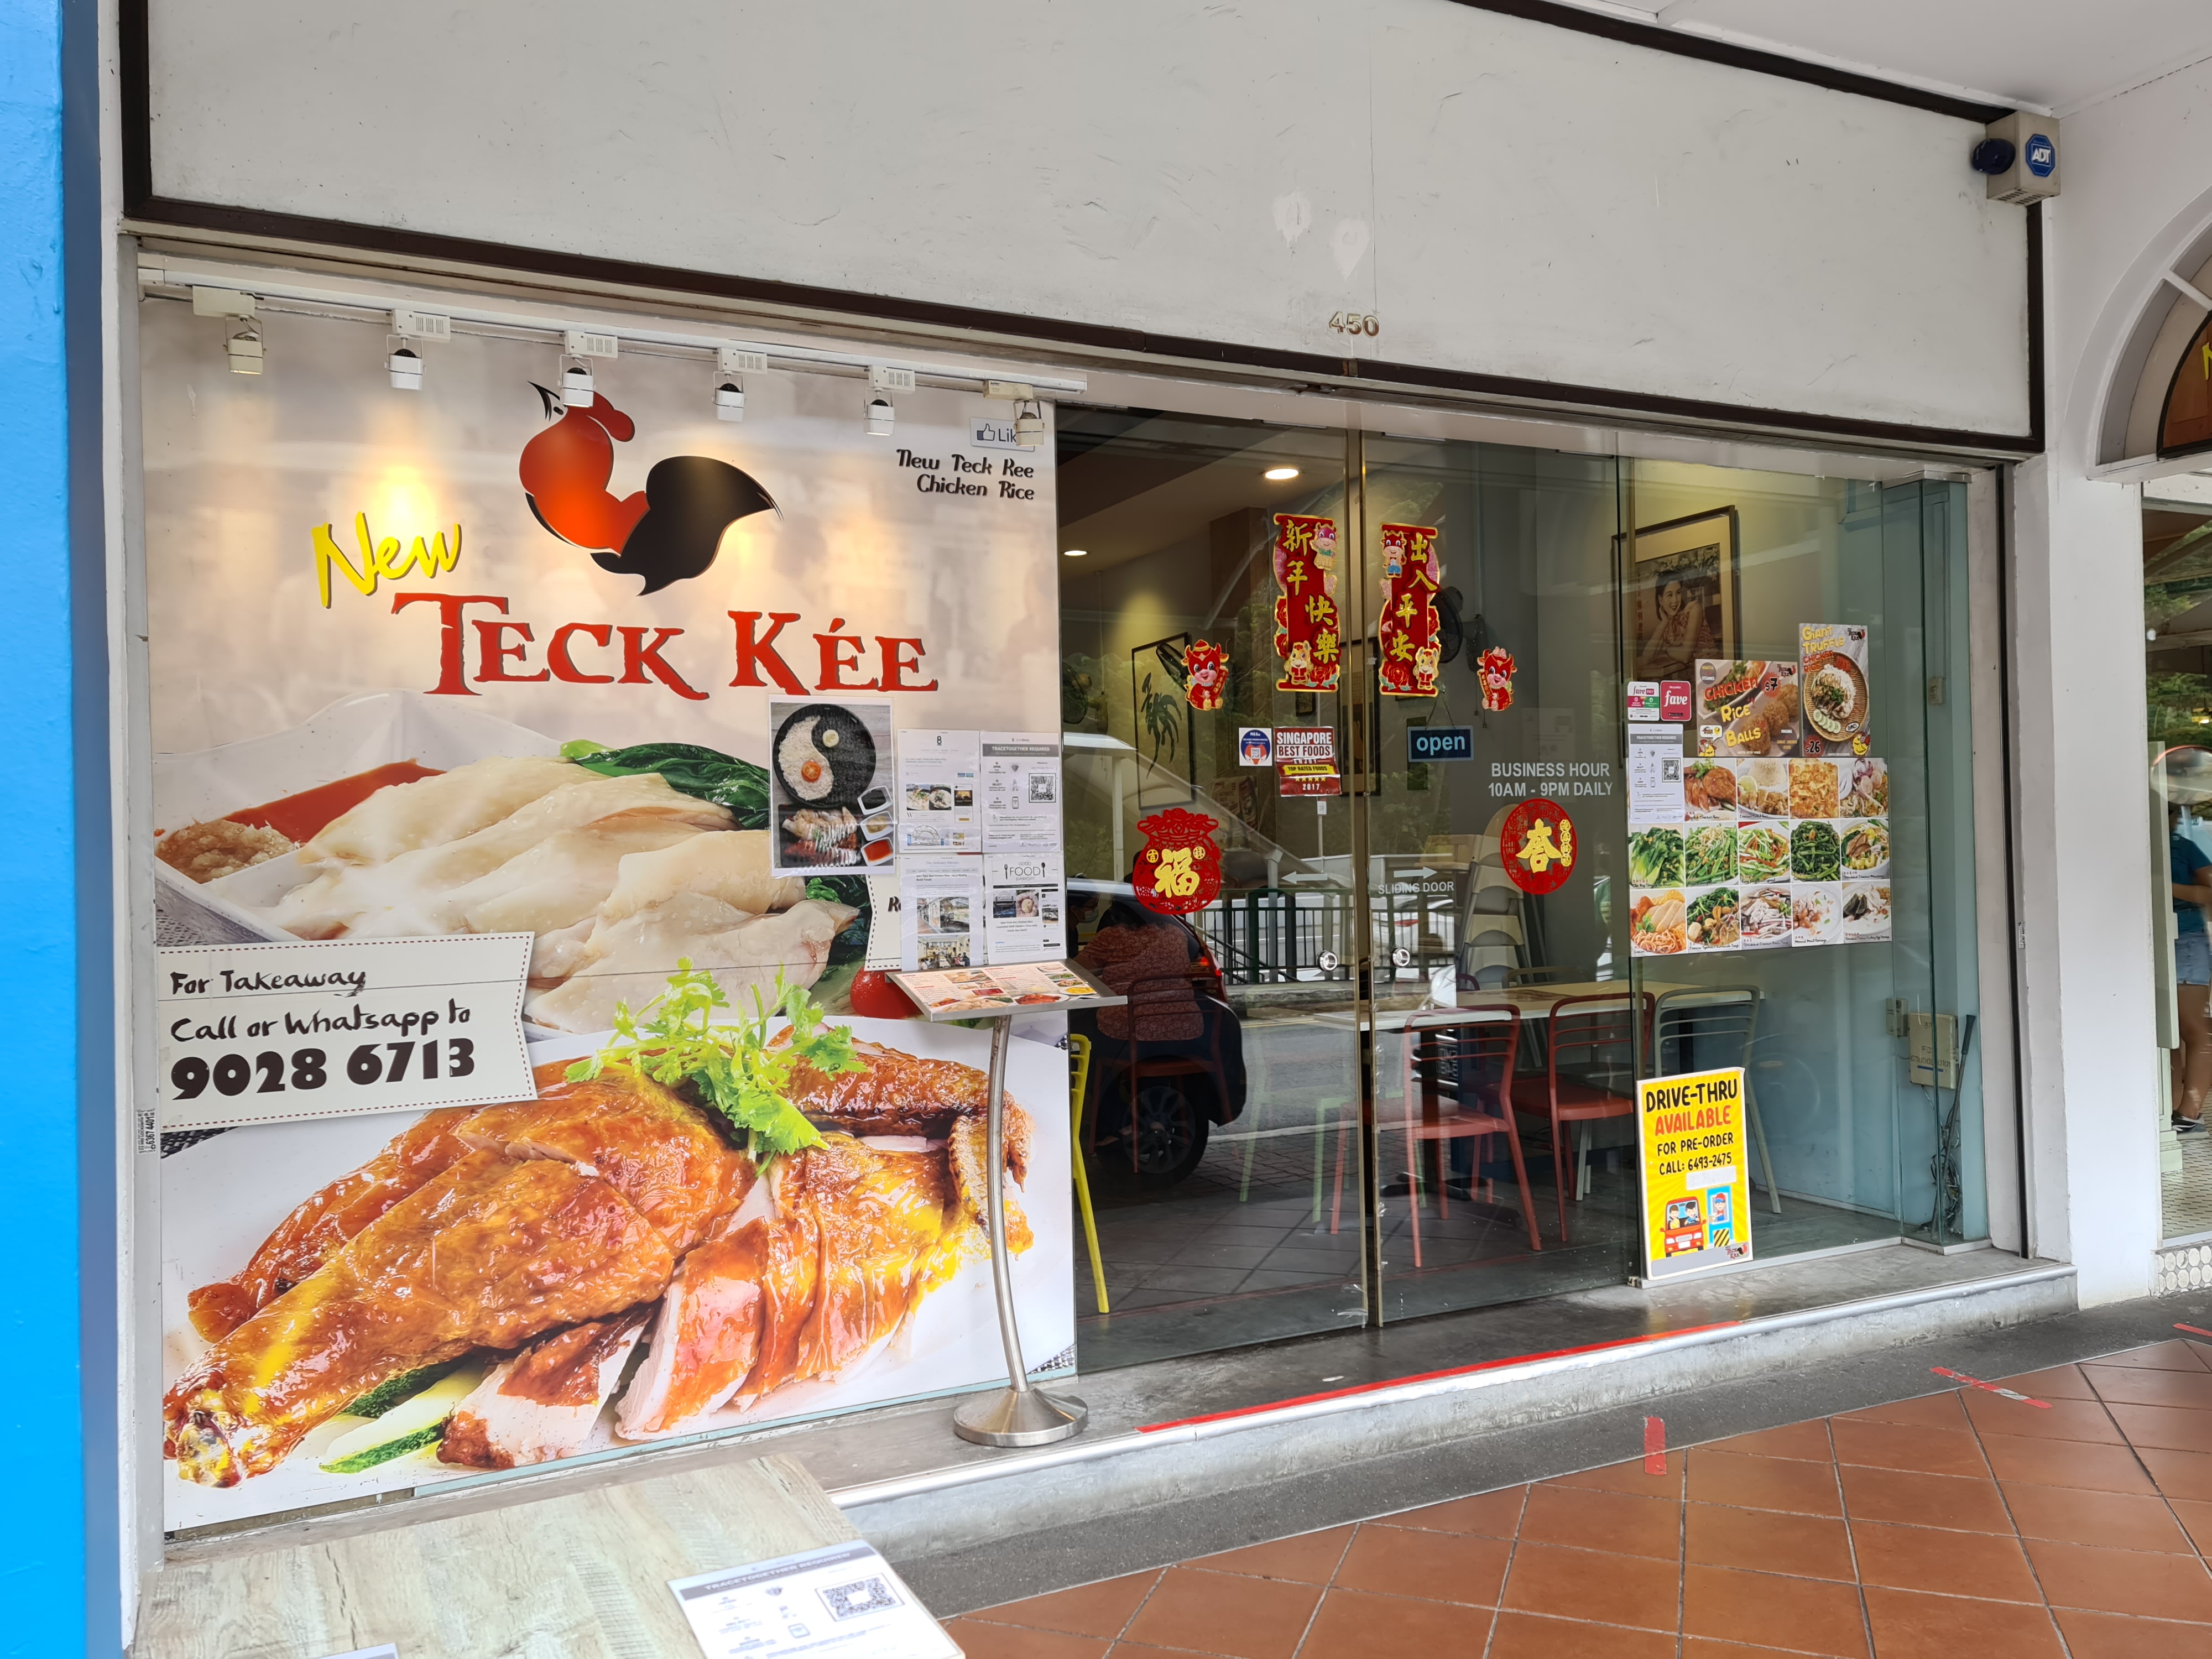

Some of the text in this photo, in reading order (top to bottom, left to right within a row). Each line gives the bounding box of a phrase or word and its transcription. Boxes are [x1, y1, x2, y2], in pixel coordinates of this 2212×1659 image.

[2032, 148, 2051, 164] ADT
[1329, 311, 1379, 338] 450
[998, 428, 1018, 443] Lik
[896, 448, 1034, 478] New Teck Kee
[916, 474, 1034, 500] Chicken Rice
[311, 511, 462, 608] New
[1282, 519, 1339, 664] 新年快樂
[1390, 532, 1438, 662] 出入平安
[391, 592, 938, 701] TECK KÉE
[1802, 636, 1845, 654] TRUFFLE
[1803, 650, 1834, 664] CHICKEN
[1804, 663, 1822, 674] RICE
[1633, 686, 1646, 695] fave
[1704, 677, 1758, 701] CHICKEN
[1765, 677, 1778, 691] $7
[1663, 690, 1688, 707] fave
[1721, 705, 1751, 722] RICE
[1277, 732, 1332, 744] SINGAPORE
[1416, 735, 1465, 755] open
[1726, 727, 1762, 747] BALLS
[1806, 740, 1821, 753] $26
[1279, 746, 1331, 756] BEST FOODS
[1491, 763, 1610, 778] BUSINESS HOUR
[1489, 782, 1526, 797] 10AM
[1541, 782, 1569, 796] 9PM
[1574, 782, 1613, 796] DAILY
[1147, 850, 1159, 863] 吉
[1010, 867, 1041, 876] FOOD
[1154, 847, 1200, 898] 福
[1378, 881, 1454, 895] SLIDING DOOR
[170, 969, 366, 997] For Takeaway
[170, 1015, 237, 1042] Call
[247, 1021, 279, 1038] or
[448, 998, 470, 1024] to
[170, 1038, 475, 1101] 9028 6713
[1646, 1078, 1738, 1113] DRIVE-THRU
[1655, 1105, 1731, 1136] AVAILABLE
[145, 1117, 155, 1145] 6367 4401
[1657, 1132, 1734, 1156] FOR PRE-ORDER
[1660, 1152, 1732, 1175] CALL: 6493-2475
[704, 1552, 851, 1590] TRACETOGETHER REQUIRED
